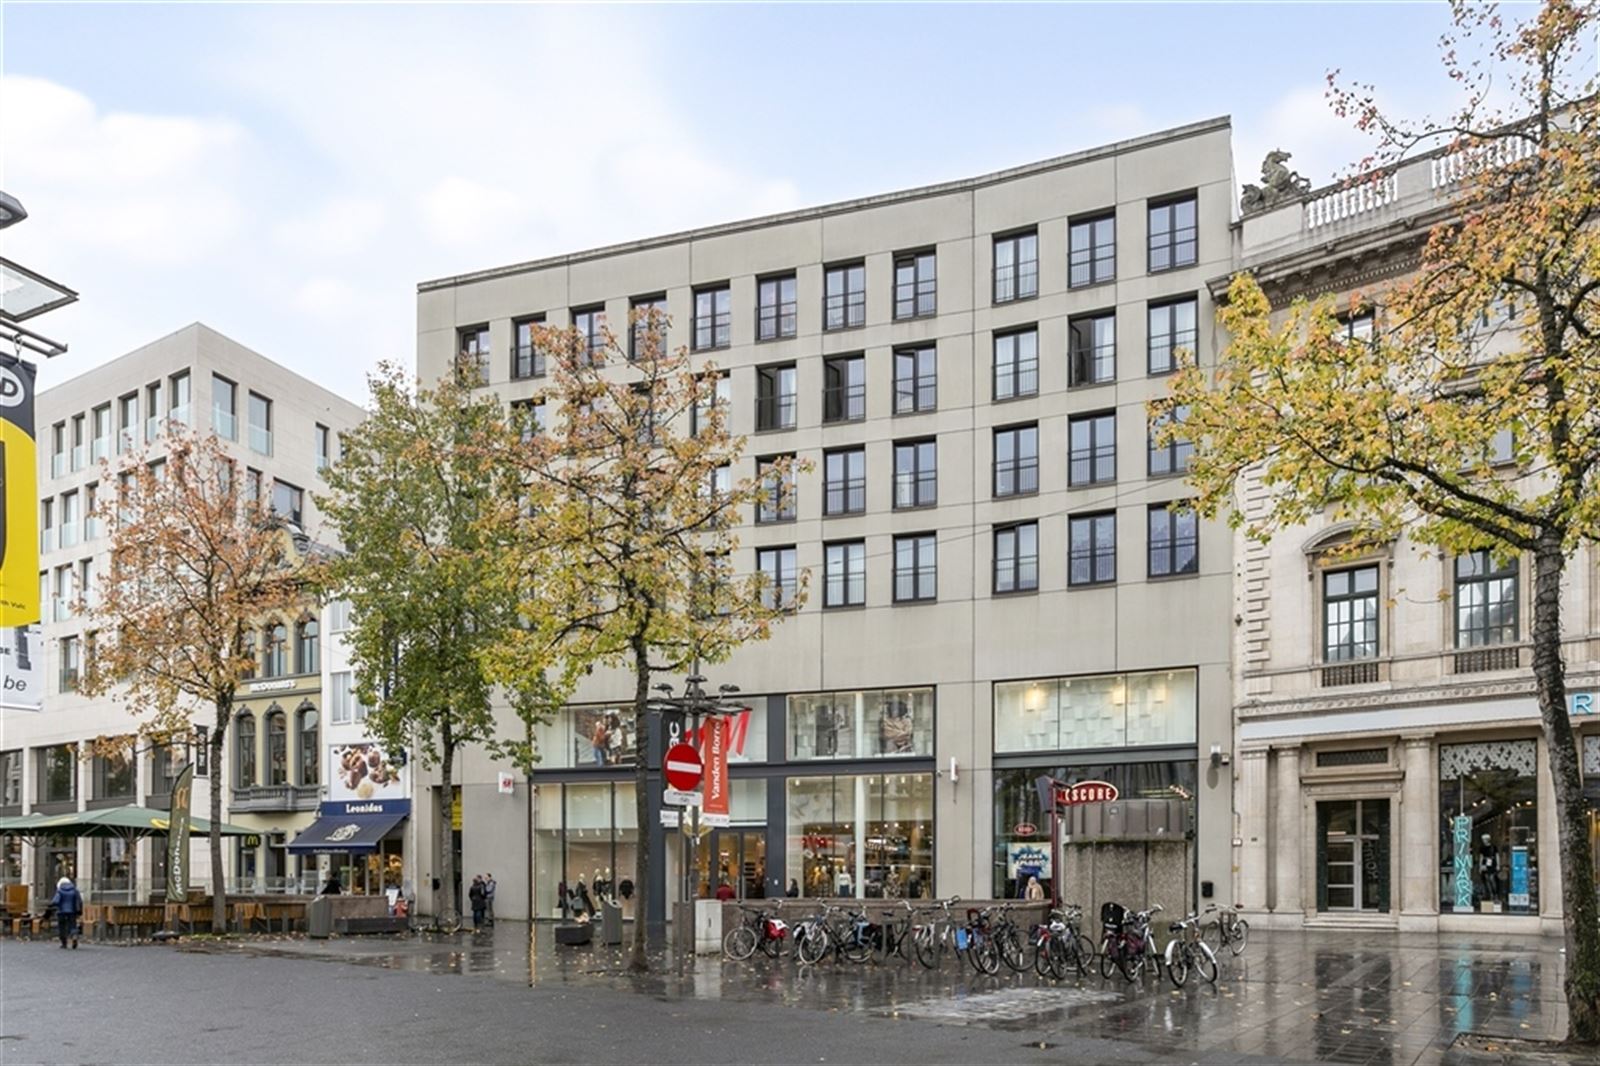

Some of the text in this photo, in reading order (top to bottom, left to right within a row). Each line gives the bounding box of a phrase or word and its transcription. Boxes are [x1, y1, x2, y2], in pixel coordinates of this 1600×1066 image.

[711, 757, 721, 800] Vanden
[345, 803, 384, 814] Leonidas
[1071, 787, 1112, 802] SCORE
[1454, 817, 1471, 907] PRIMARK
